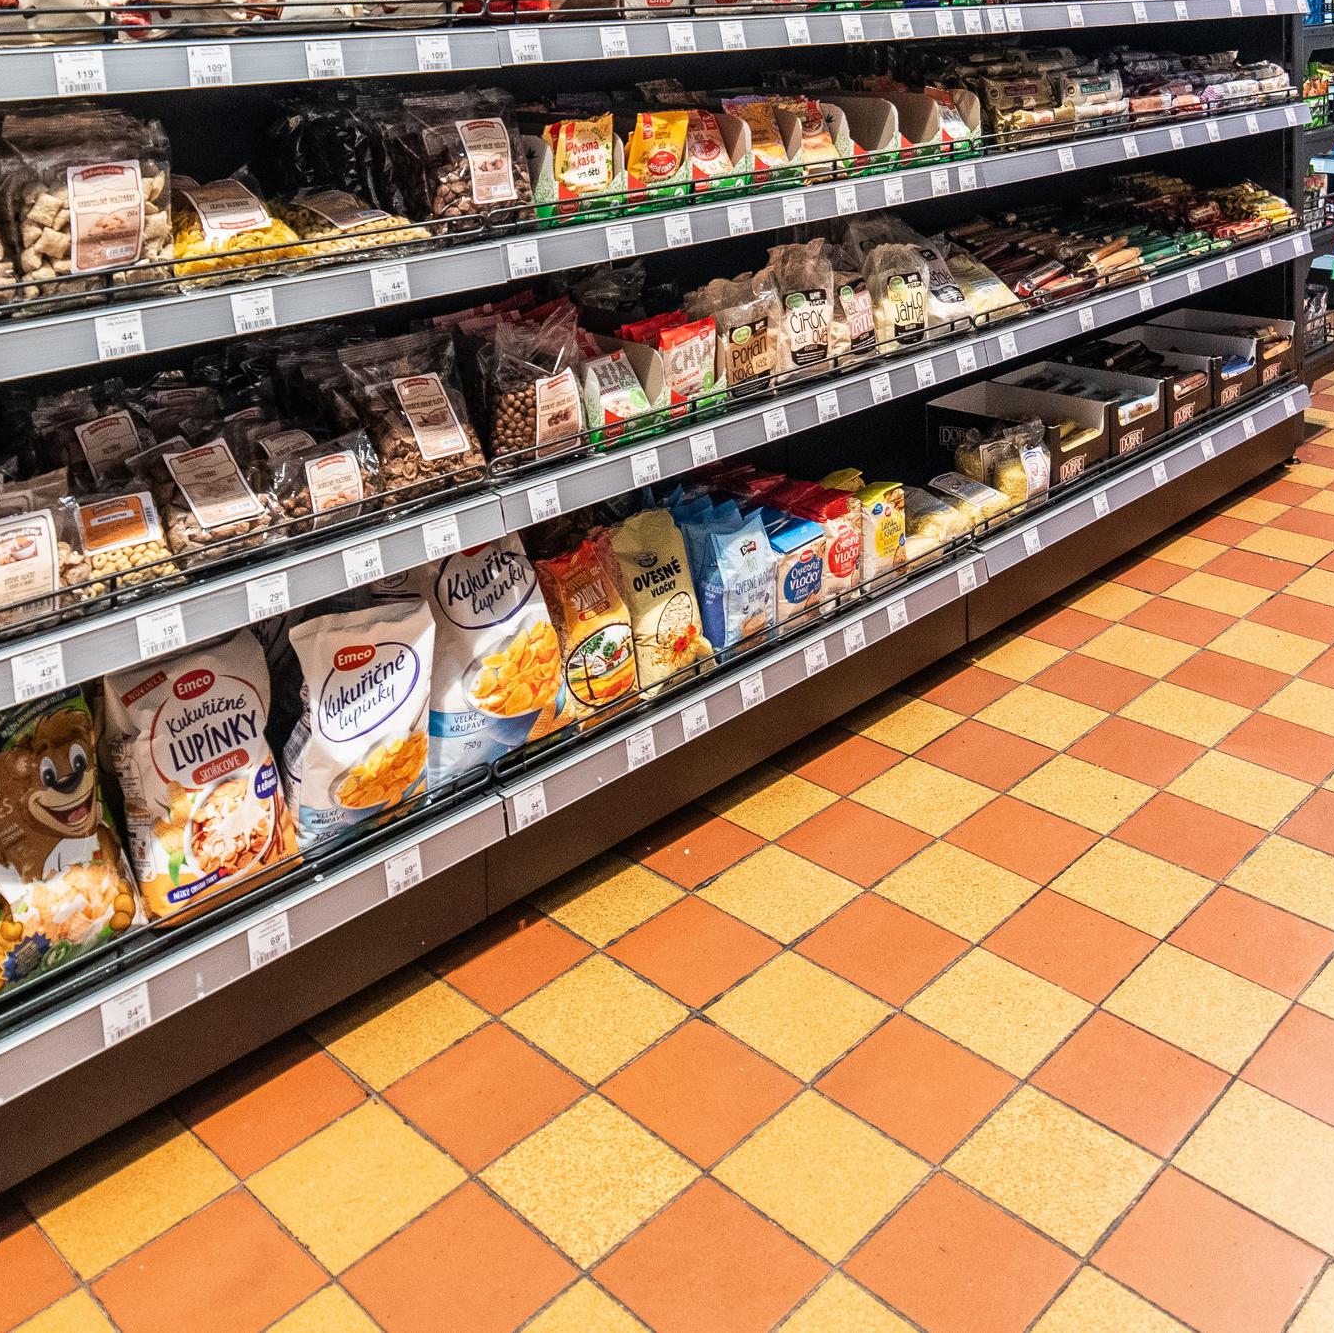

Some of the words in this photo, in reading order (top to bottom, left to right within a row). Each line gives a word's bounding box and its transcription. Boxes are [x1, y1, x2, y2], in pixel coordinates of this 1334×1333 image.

[577, 155, 595, 167] kaše
[632, 556, 684, 593] OVESNÉ
[789, 570, 821, 589] VLOČKY
[471, 563, 526, 616] lupínky
[650, 579, 677, 598] VLOČKY
[337, 647, 372, 666] Emco
[127, 672, 165, 703] NOVINKA
[177, 674, 212, 695] Emco
[323, 649, 406, 722] Kukuřičné
[165, 694, 247, 737] Kukuřičné
[338, 682, 396, 731] lupínky
[452, 713, 479, 723] VELKÉ
[449, 718, 487, 733] KŘUPAVÉ
[169, 710, 260, 770] LUPÍNKY
